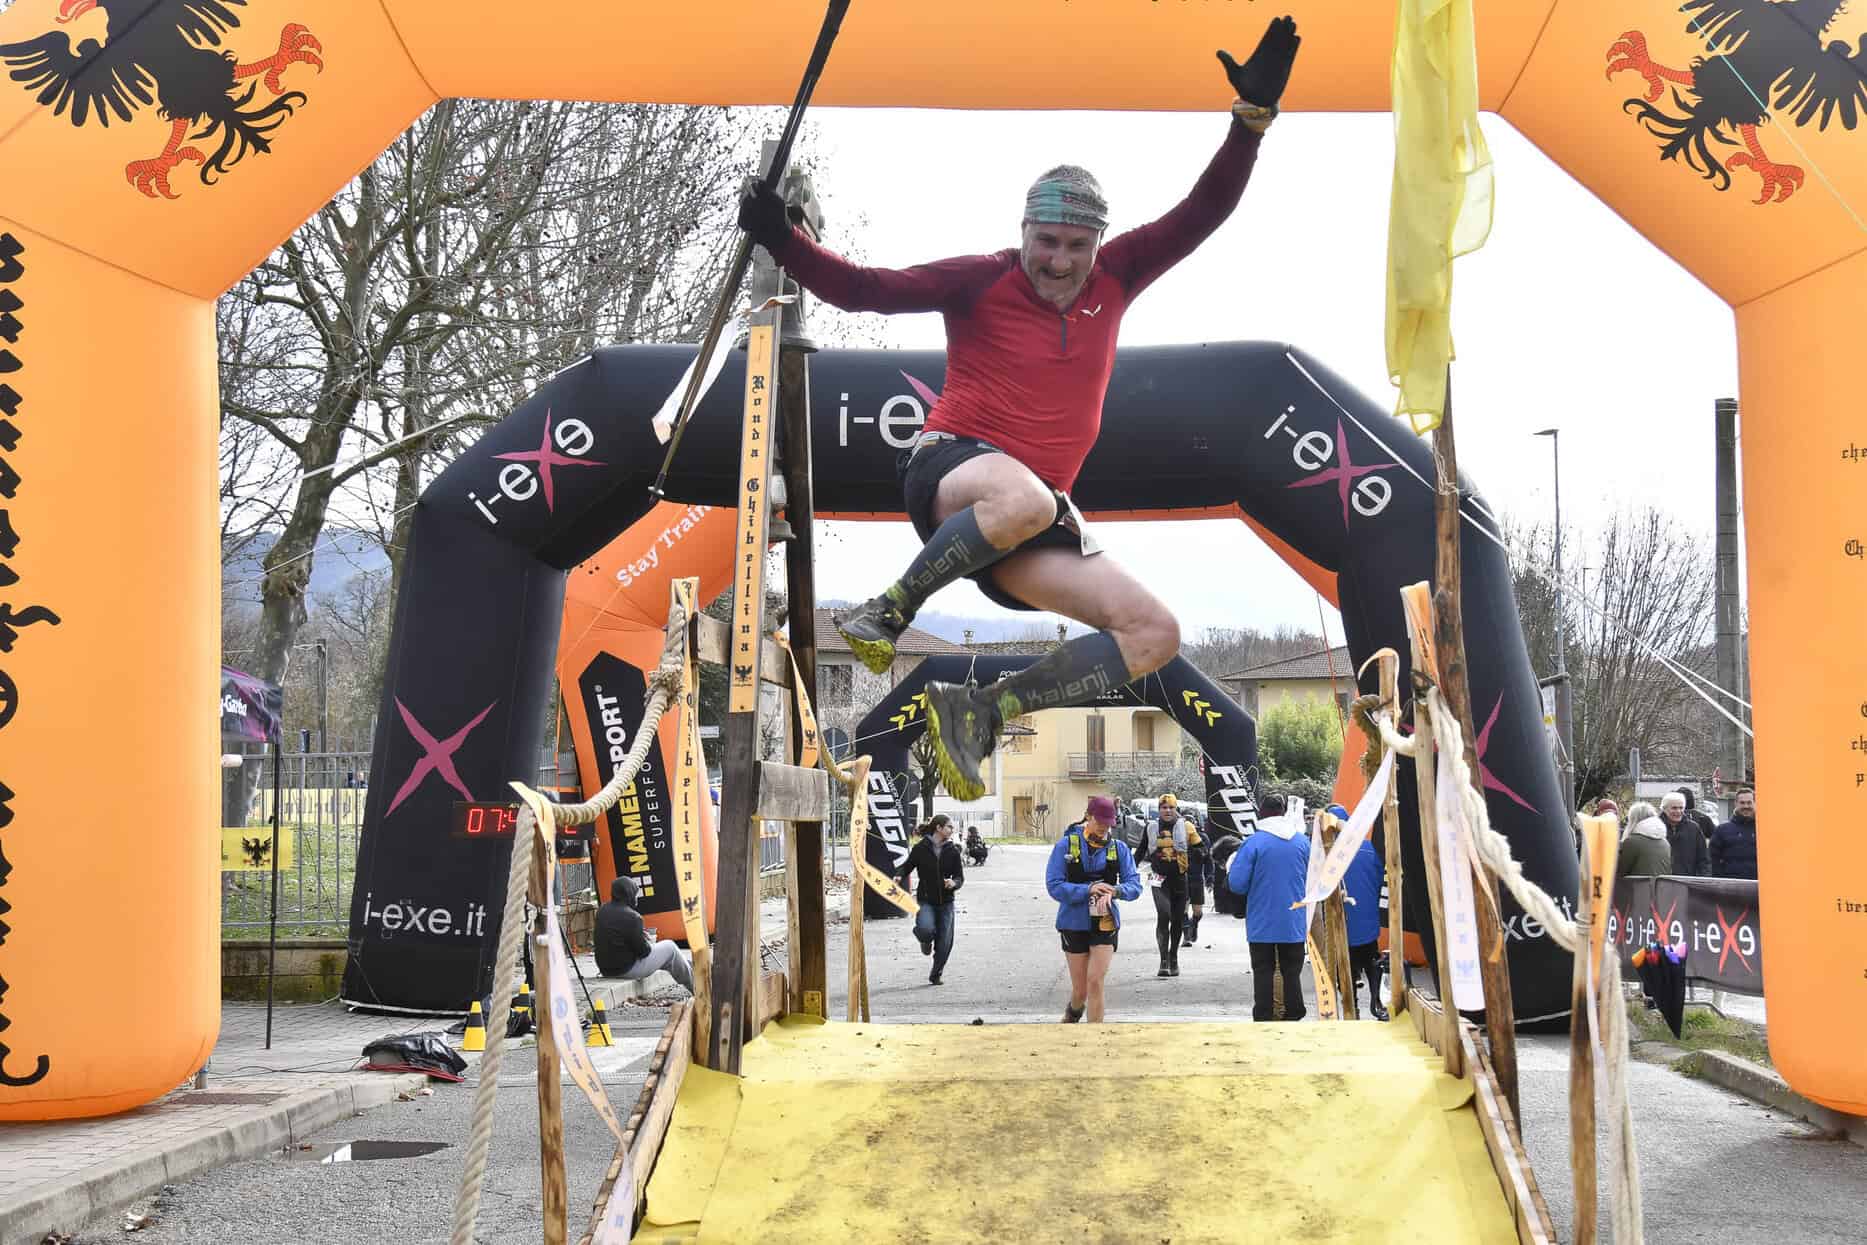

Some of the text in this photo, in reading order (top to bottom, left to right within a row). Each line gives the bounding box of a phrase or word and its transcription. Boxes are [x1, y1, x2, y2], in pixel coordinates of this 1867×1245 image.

[616, 544, 659, 587] Stay
[640, 761, 666, 849] SUPERFO
[1209, 766, 1259, 842] FUG
[363, 892, 487, 937] i-exe.it
